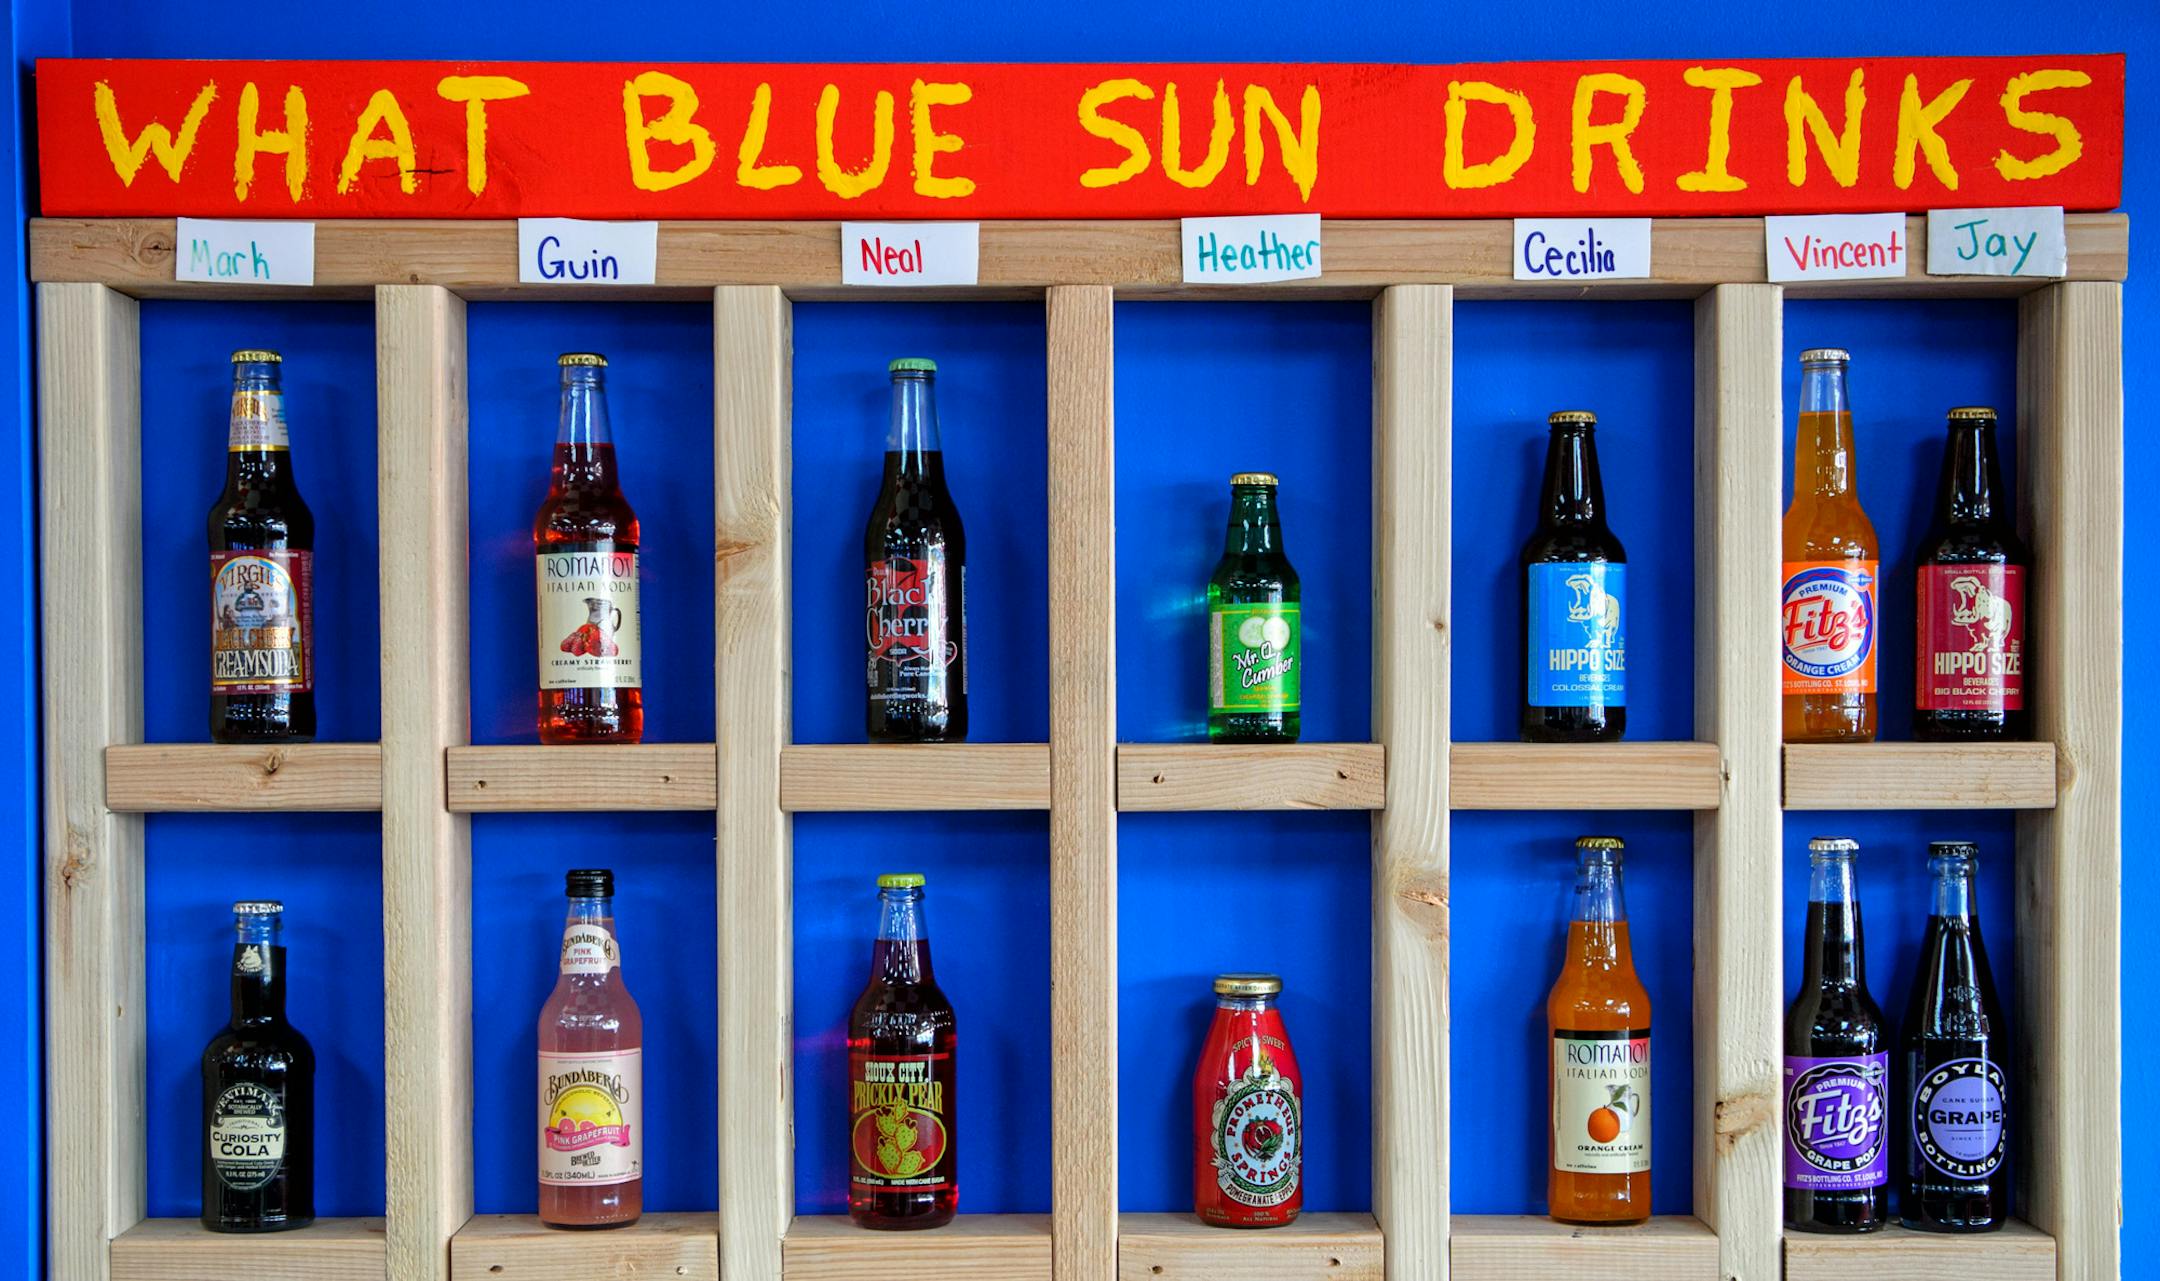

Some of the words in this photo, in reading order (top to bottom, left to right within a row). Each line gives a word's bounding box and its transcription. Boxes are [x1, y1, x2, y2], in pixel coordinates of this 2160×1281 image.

[94, 74, 530, 203] WHAT
[622, 71, 977, 200] BLUE
[1078, 78, 1321, 203] SUN
[1443, 66, 2092, 195] DRINKS
[536, 234, 620, 280] Guin
[860, 237, 924, 276] Neal
[1197, 229, 1320, 275] Heather
[1523, 227, 1617, 275] Cecilia
[1785, 231, 1904, 271] Vincent
[1952, 219, 2037, 275] Jay
[189, 238, 271, 280] Mark
[547, 581, 595, 593] ITALIAN
[1798, 583, 1849, 598] PREMIUM
[1782, 584, 1870, 651] Fitz's
[1232, 648, 1260, 671] Mr.
[1241, 651, 1294, 689] Cumber
[1549, 649, 1600, 671] HIPPO
[1604, 649, 1626, 671] SIZE
[1785, 654, 1825, 675] ORANGE
[1826, 654, 1860, 675] CREAM
[1934, 652, 1986, 675] HIPPO
[1991, 652, 2021, 675] SIZE
[1934, 687, 1950, 695] BIG
[1952, 687, 1986, 695] BLACK
[1988, 687, 2020, 696] CHERRY
[1262, 1035, 1286, 1051] SWEET
[864, 1061, 896, 1083] SIOUX
[1566, 1067, 1617, 1080] ITALIAN
[544, 1066, 630, 1106] BUNDABERG
[1815, 1078, 1866, 1093] PREMIUM
[853, 1080, 905, 1114] PRICKLY
[908, 1080, 944, 1115] PEAR
[1226, 1090, 1295, 1137] PROMETHEUS
[1796, 1088, 1883, 1146] Fitz's
[1929, 1109, 2001, 1125] GRAPE
[212, 1131, 281, 1143] CURIOSITY
[553, 1133, 570, 1145] PINK
[571, 1126, 620, 1145] GRAPEFRUIT
[220, 1142, 270, 1156] COLA
[1577, 1144, 1615, 1152] ORANGE
[1618, 1143, 1643, 1151] CREAM
[1806, 1149, 1851, 1170] GRAPE
[1855, 1147, 1876, 1168] POP
[1919, 1131, 1997, 1175] BOTTLING
[1231, 1151, 1292, 1183] SPRINGS
[1812, 1174, 1841, 1184] BOTTLING
[1225, 1183, 1275, 1205] POMEGRANATE
